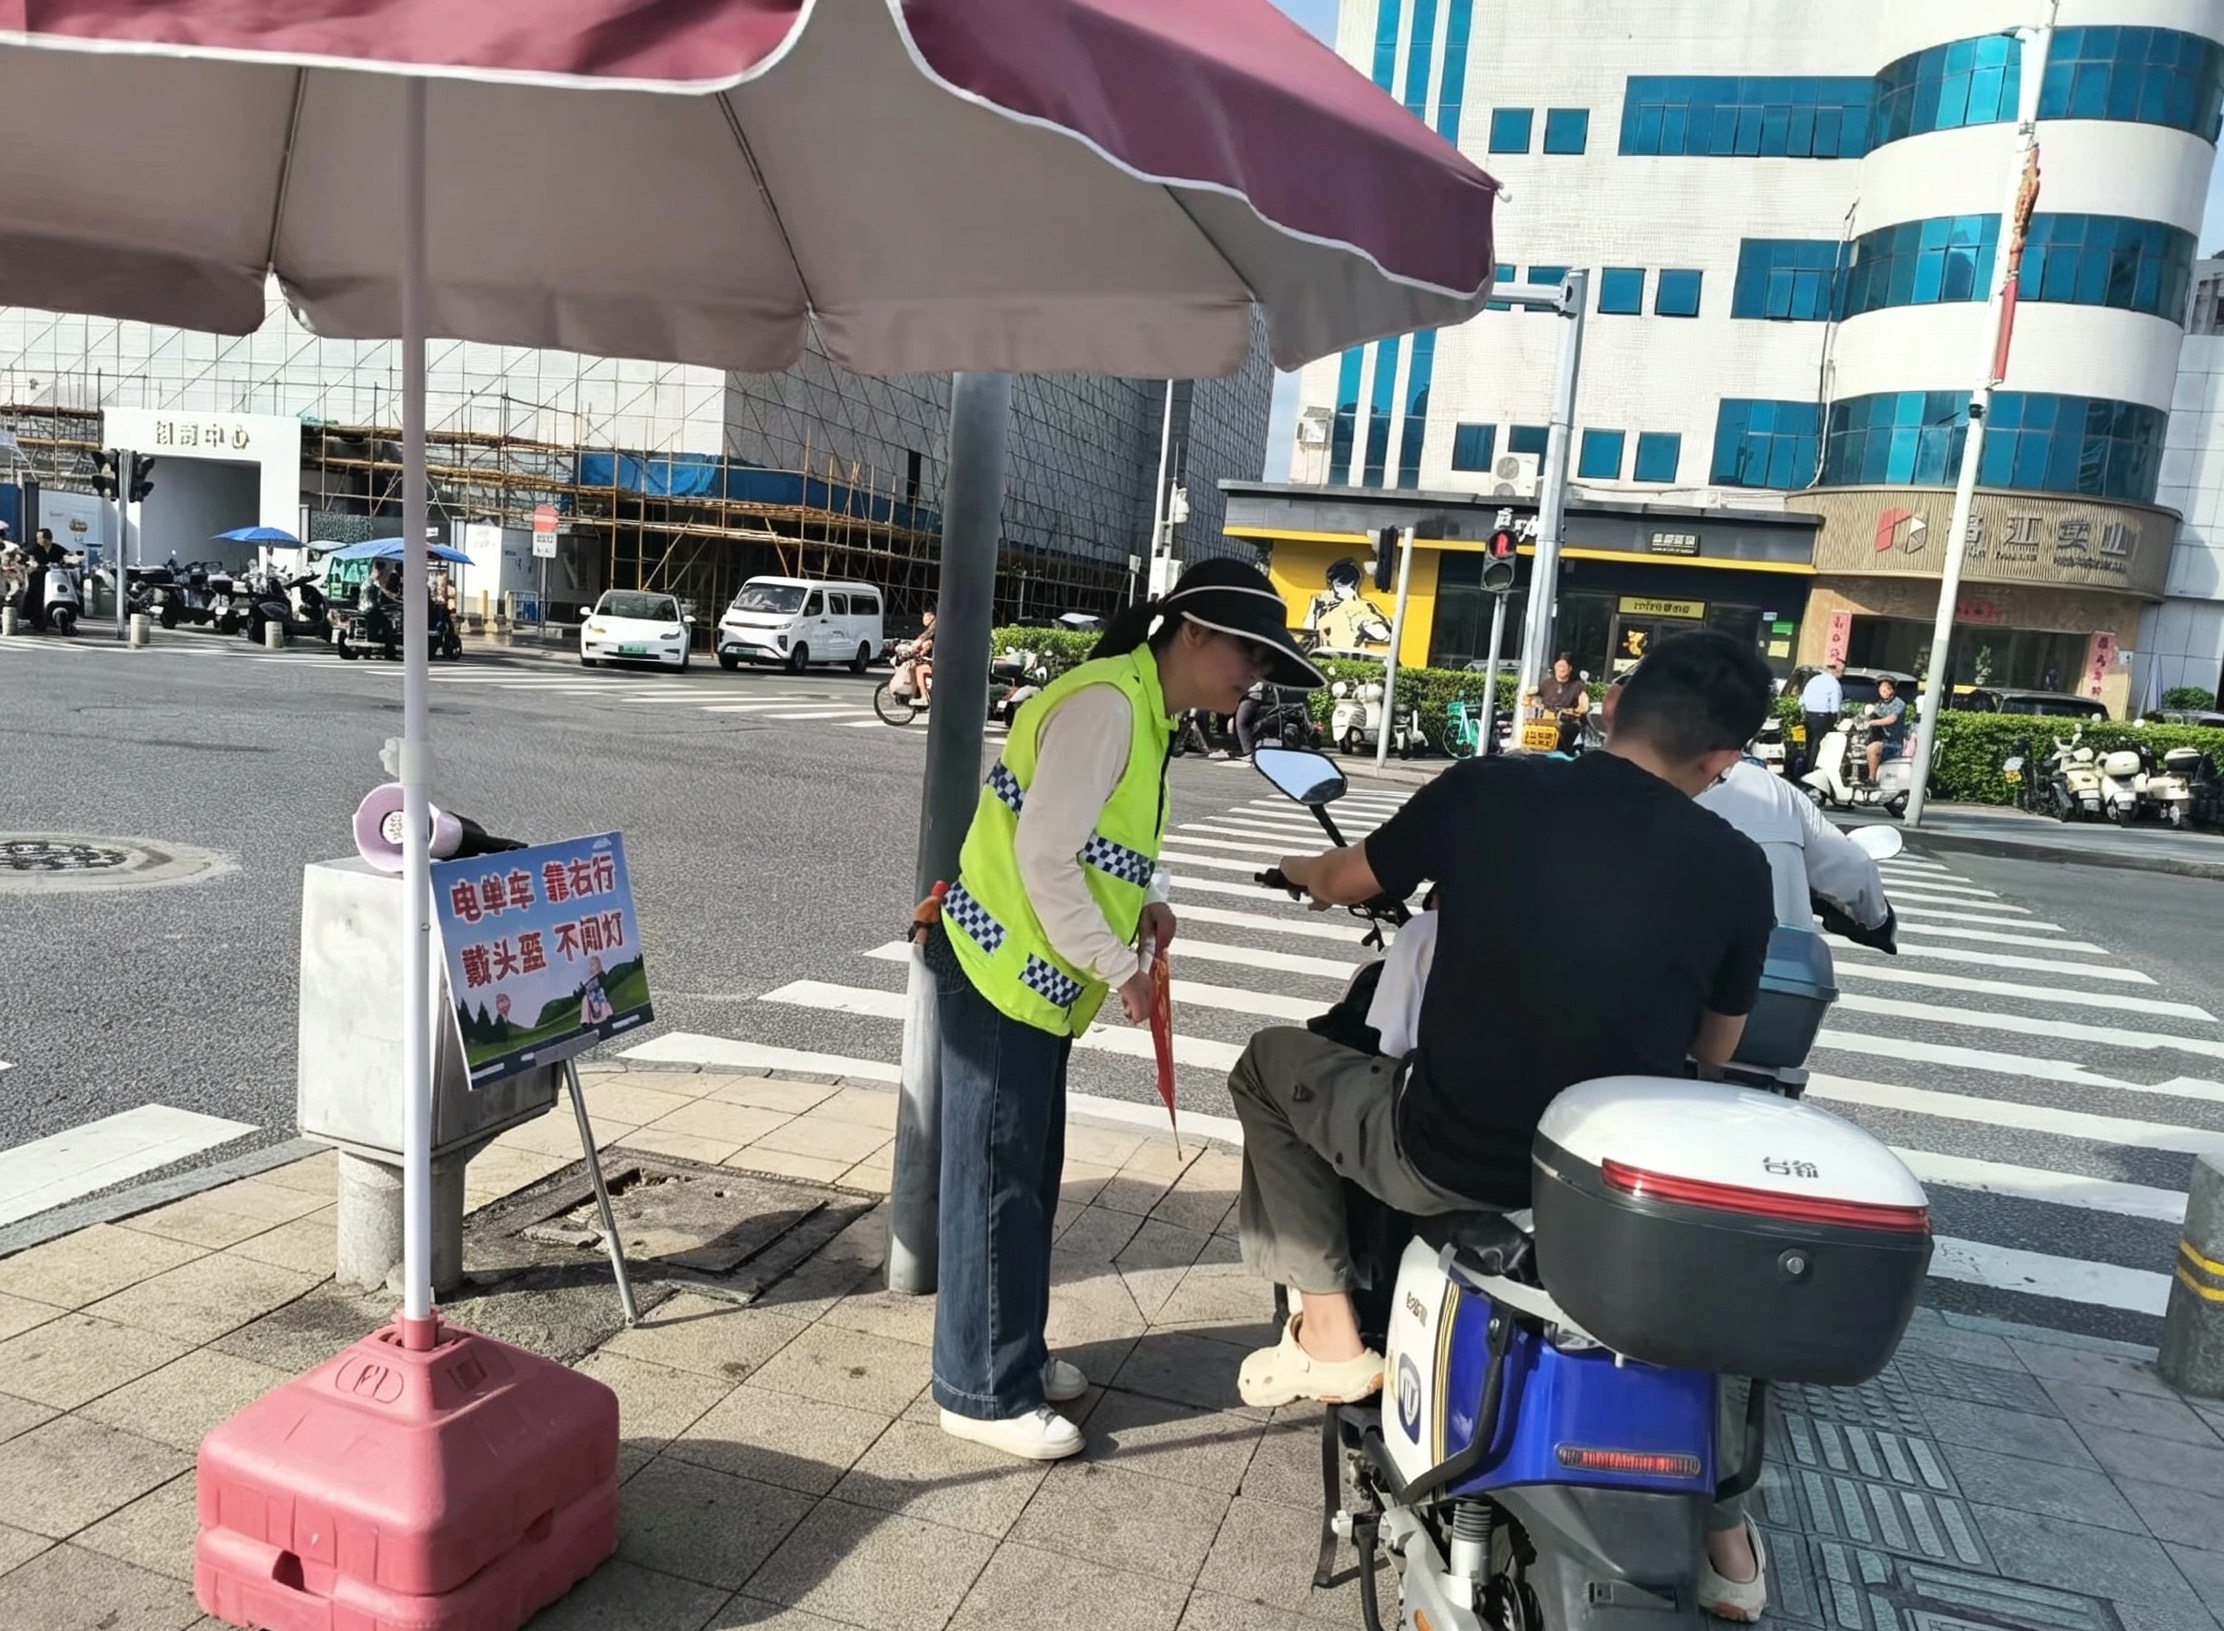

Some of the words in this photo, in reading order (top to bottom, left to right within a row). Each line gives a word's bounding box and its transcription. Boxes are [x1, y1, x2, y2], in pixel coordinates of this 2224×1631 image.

[451, 869, 537, 923] 电单车
[543, 852, 616, 902] 靠右行
[461, 931, 547, 989] 戴头盔
[553, 910, 625, 963] 不闯灯
